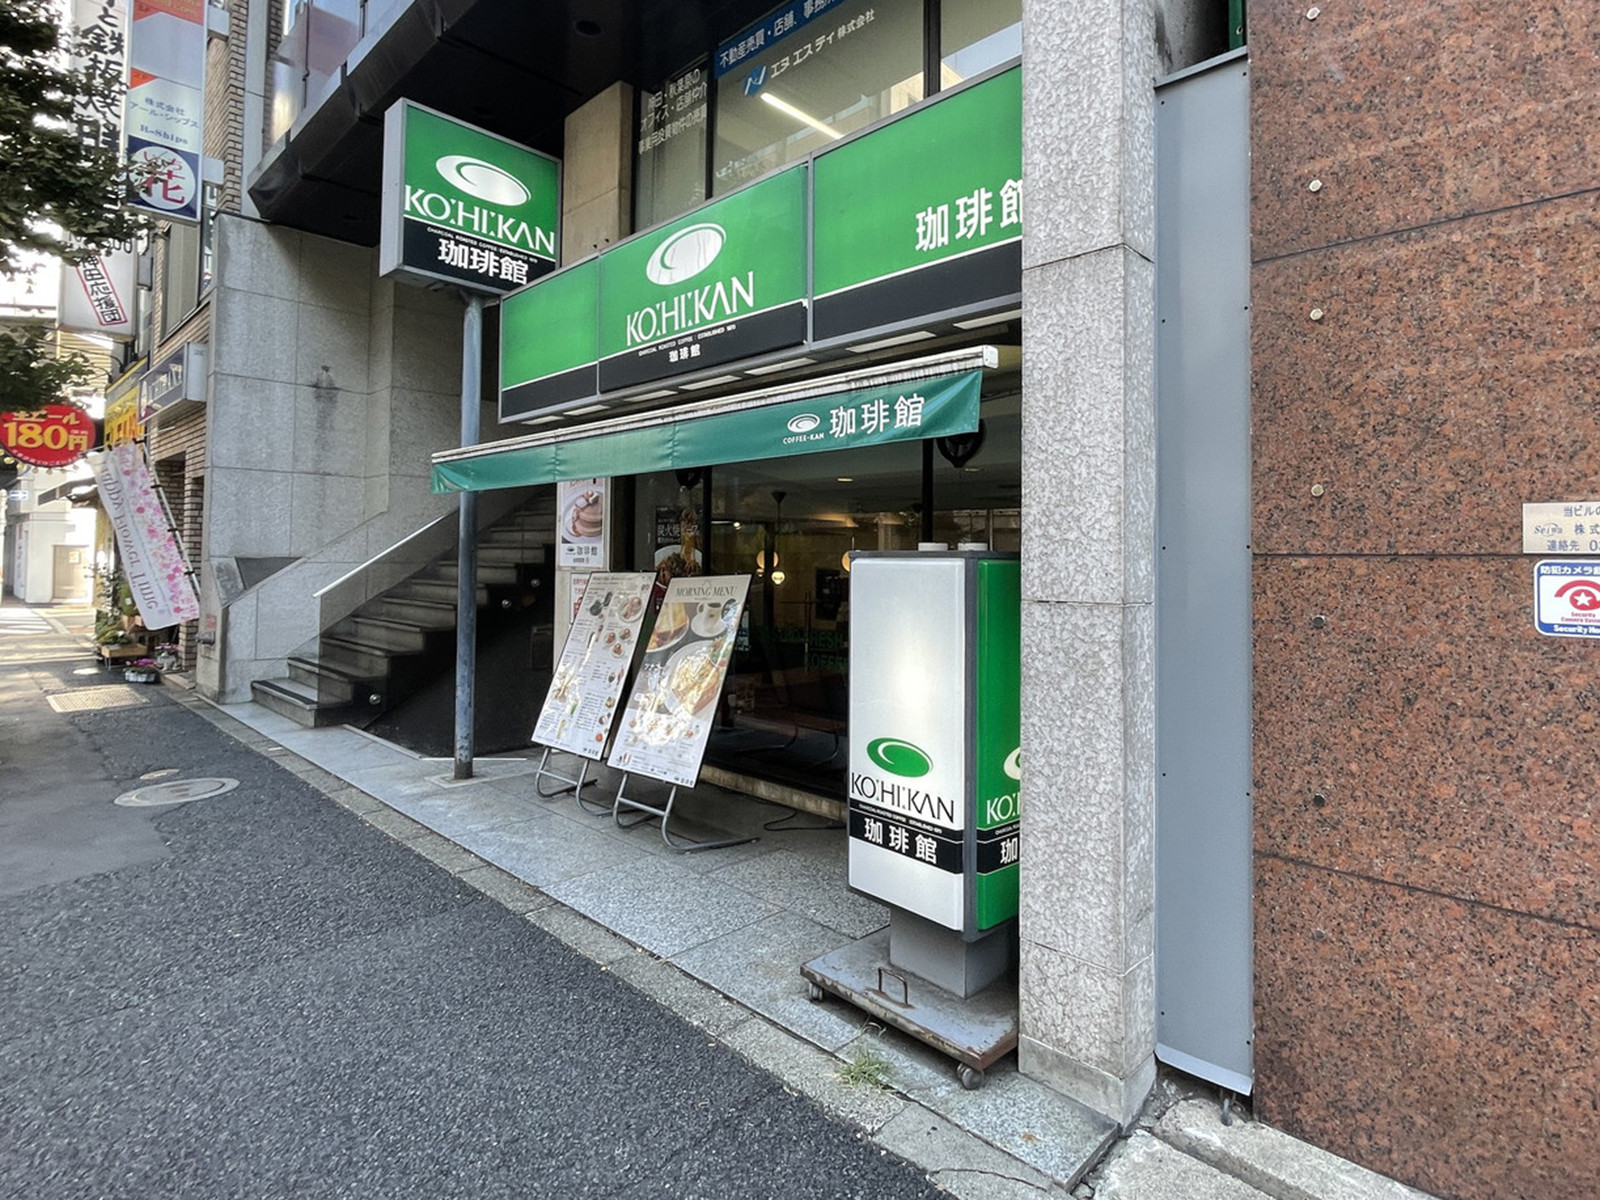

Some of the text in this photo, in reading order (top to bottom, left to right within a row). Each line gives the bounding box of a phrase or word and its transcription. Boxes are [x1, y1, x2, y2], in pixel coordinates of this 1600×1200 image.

[437, 238, 529, 285] 珈琲館
[668, 343, 701, 363] 珈琲館
[829, 393, 925, 438] 珈琲館
[782, 432, 825, 445] COFFEE-KAN
[1547, 539, 1600, 551] 連絡先 0
[675, 585, 738, 597] MORNING MENU
[1553, 624, 1588, 635] Security
[863, 817, 938, 865] 珈琲館
[1000, 837, 1018, 864] 珈
